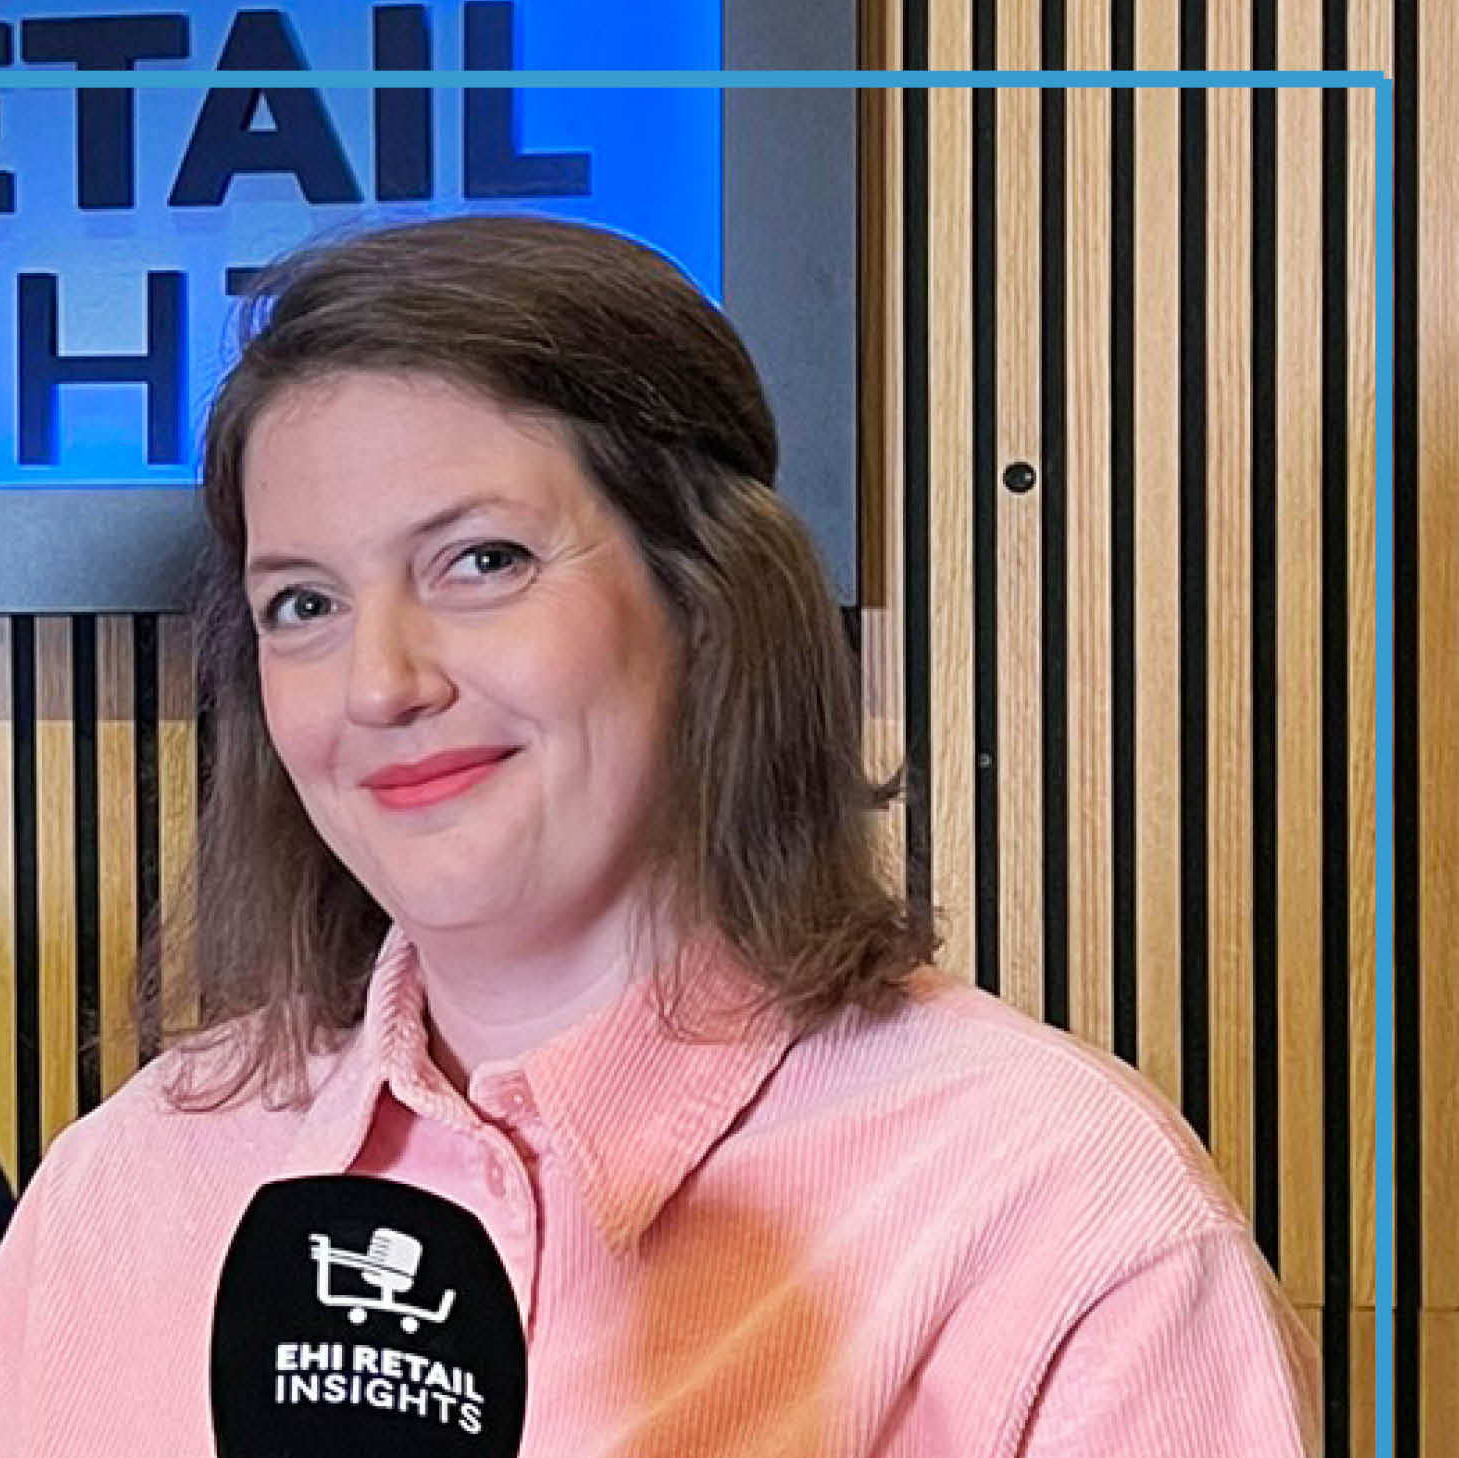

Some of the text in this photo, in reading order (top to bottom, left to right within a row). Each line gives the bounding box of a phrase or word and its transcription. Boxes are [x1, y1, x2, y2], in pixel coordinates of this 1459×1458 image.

[275, 1343, 484, 1403] EHI RETAIL
[275, 1373, 482, 1434] INSIGHTS
